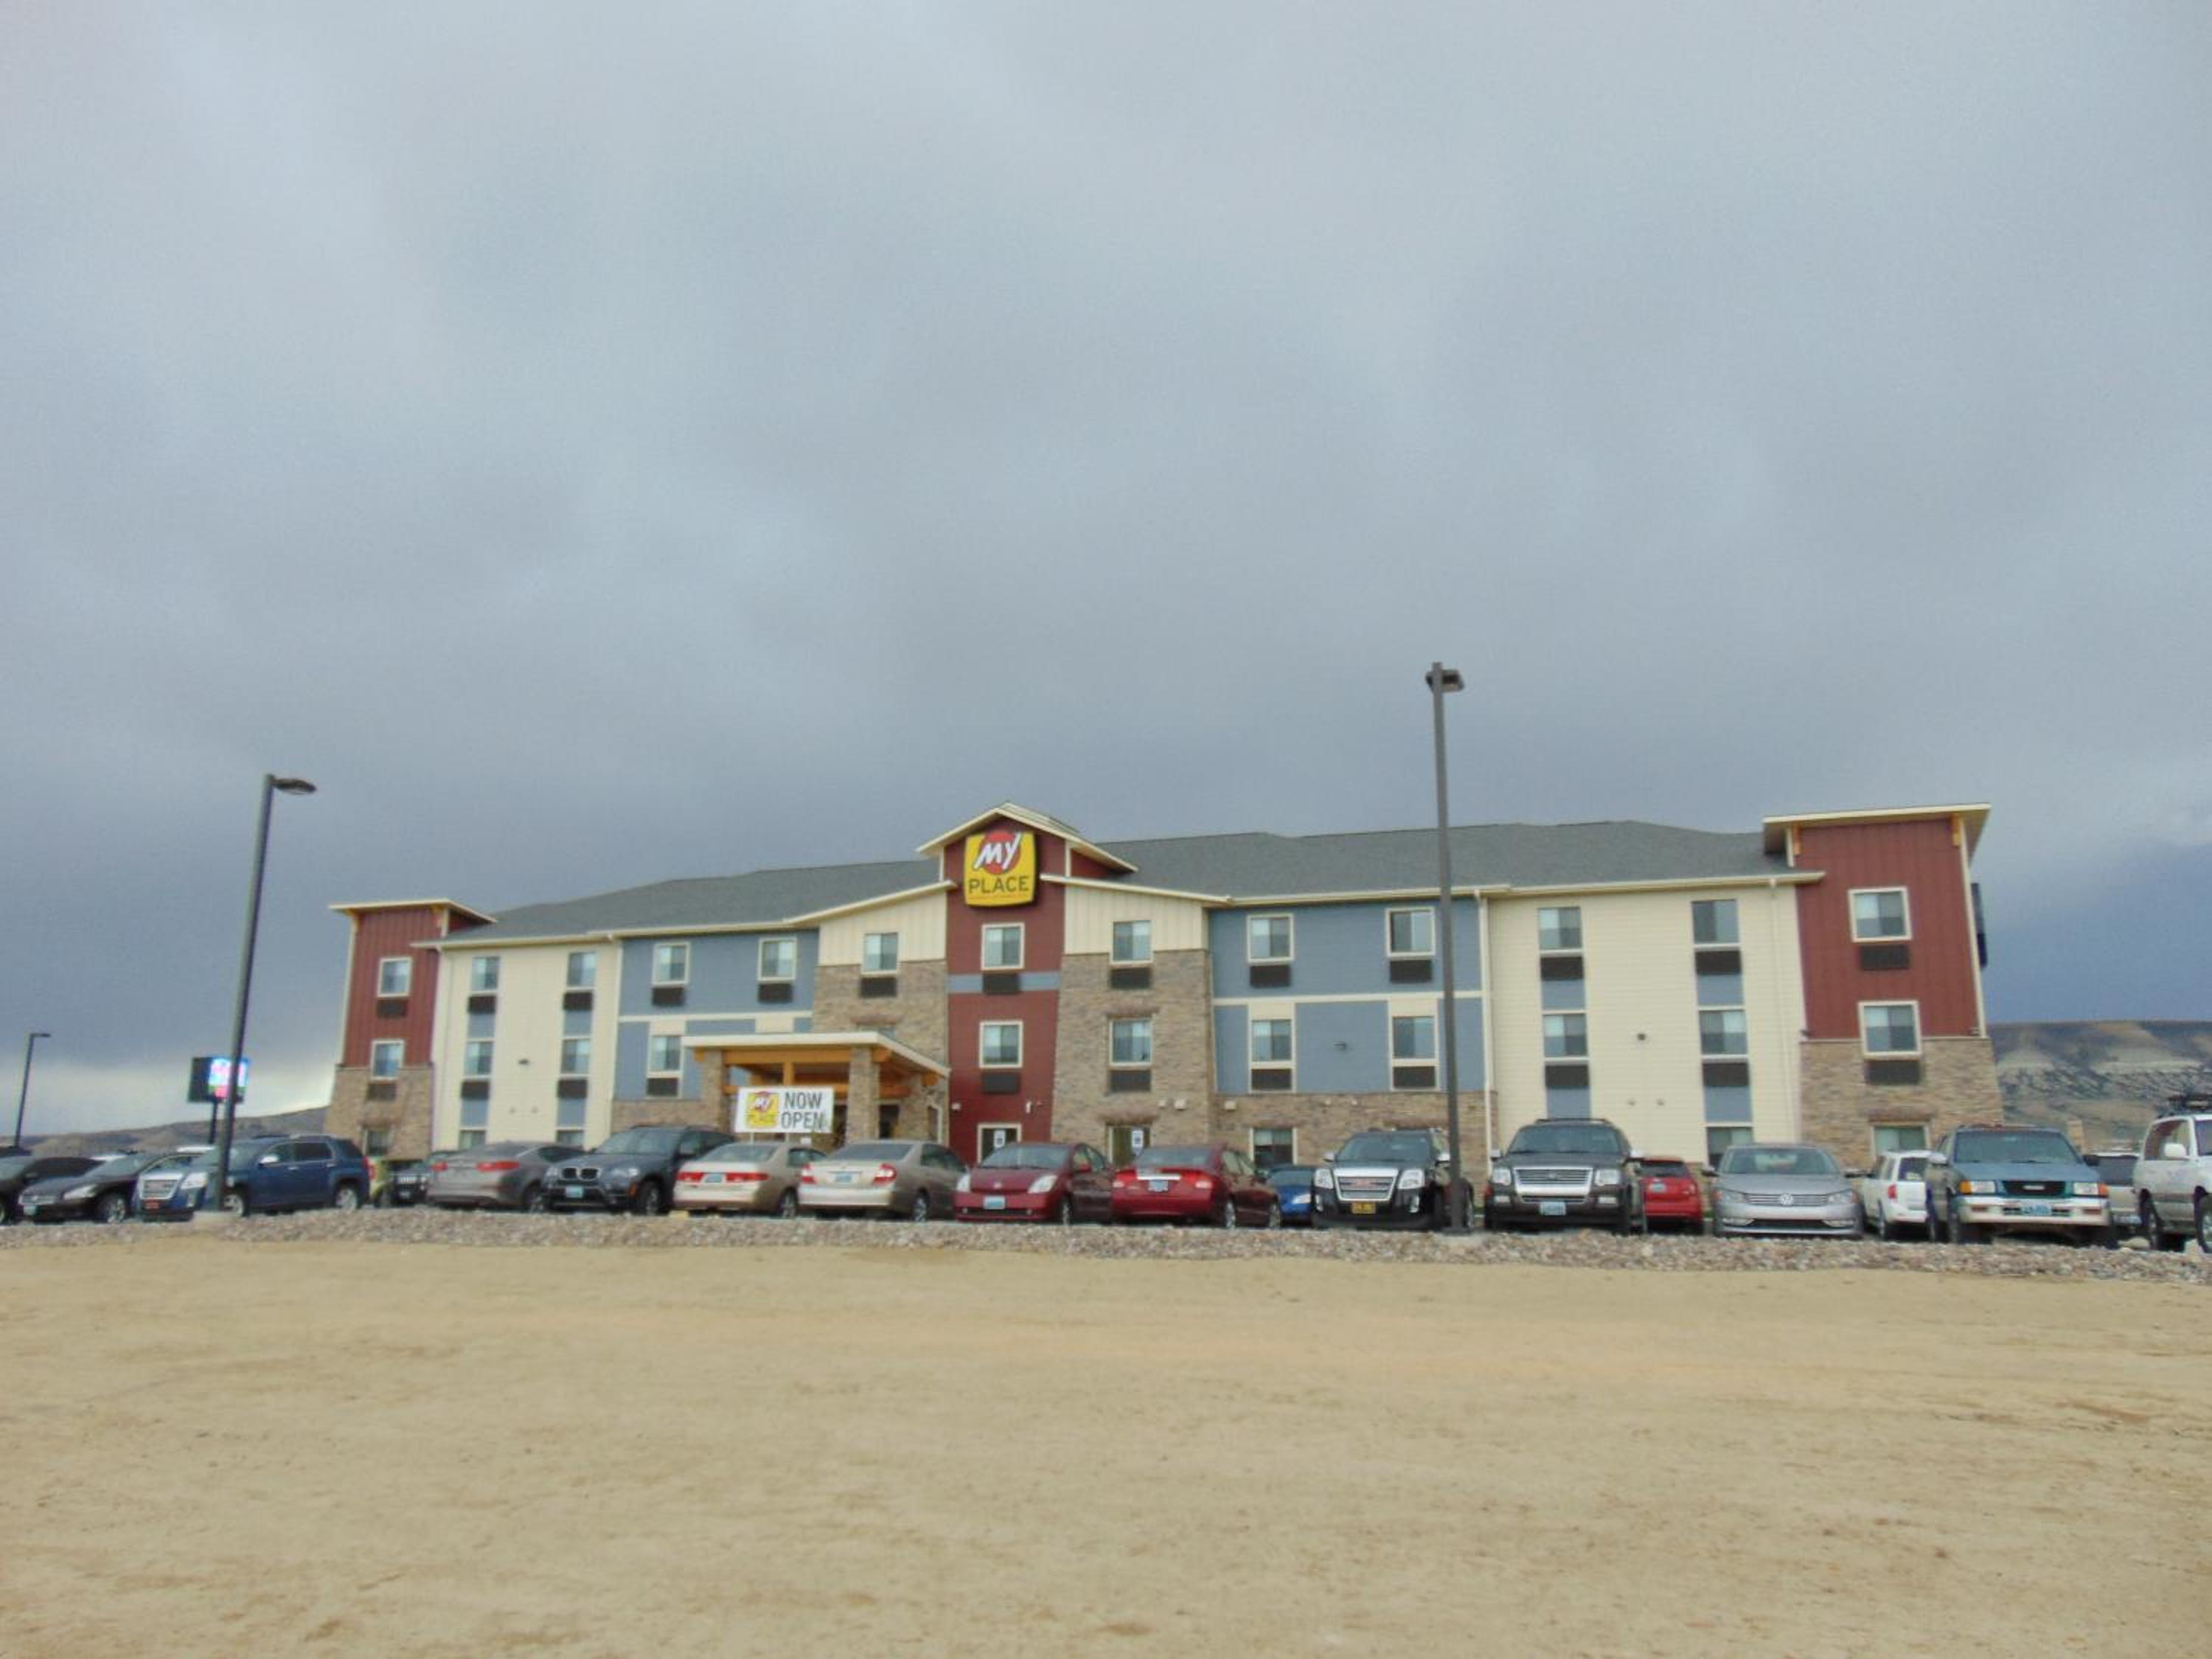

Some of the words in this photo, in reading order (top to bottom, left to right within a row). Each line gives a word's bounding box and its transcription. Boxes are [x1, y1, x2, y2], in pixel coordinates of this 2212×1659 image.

[968, 875, 1029, 894] PLACE
[784, 1092, 822, 1109] NOW
[782, 1111, 824, 1129] OPEN
